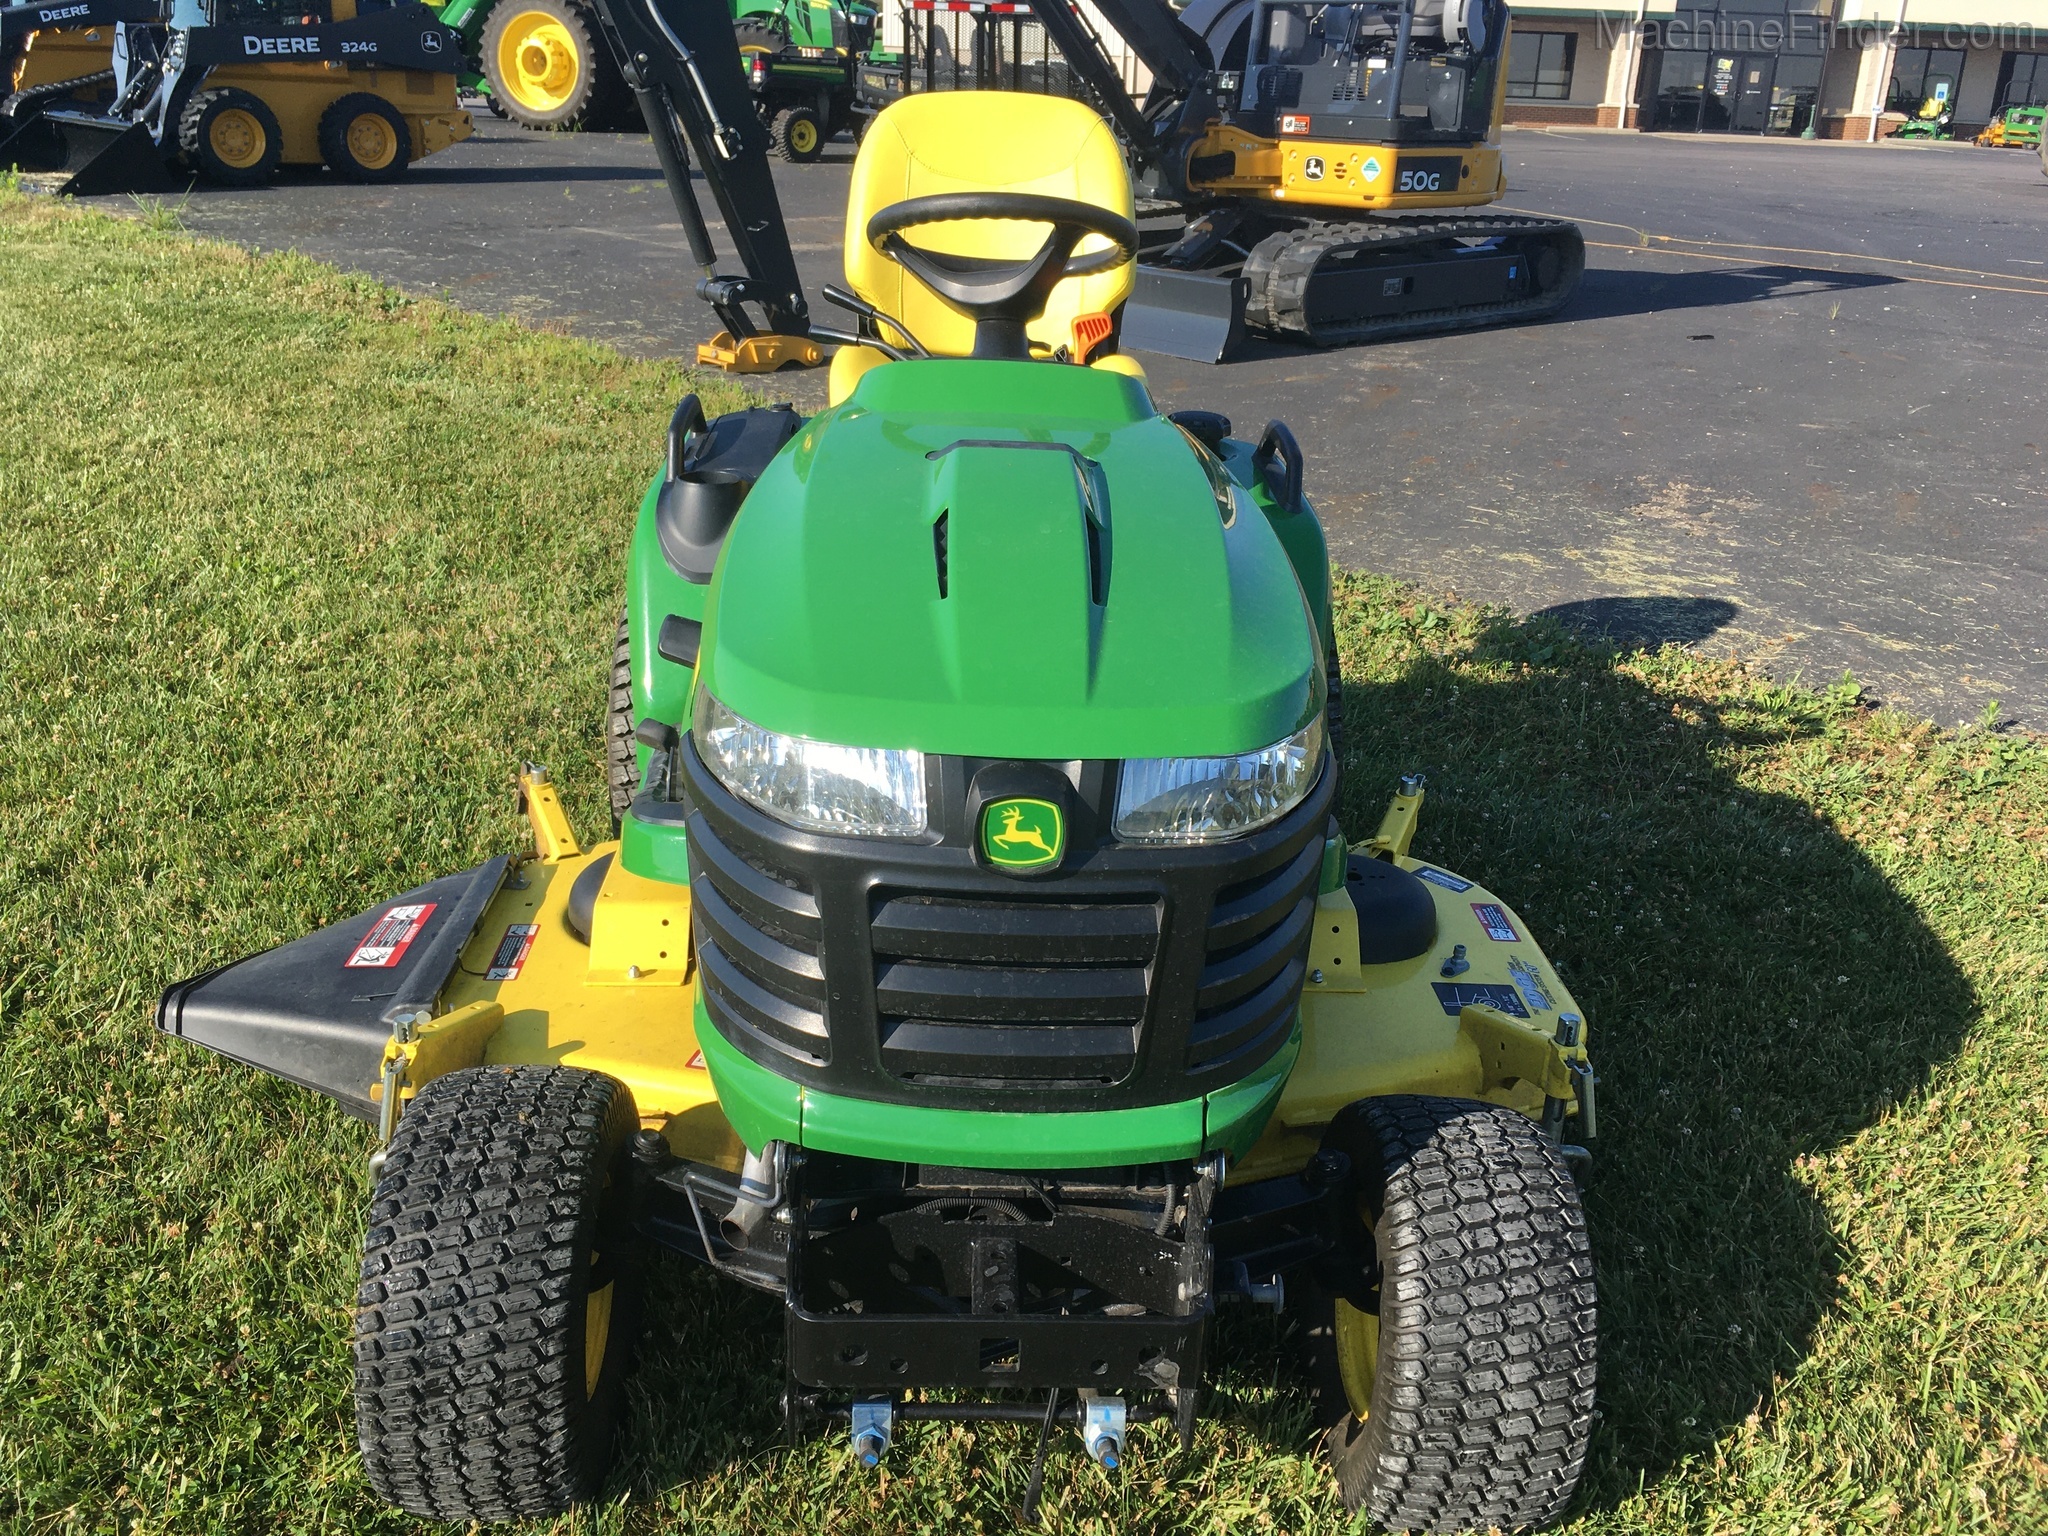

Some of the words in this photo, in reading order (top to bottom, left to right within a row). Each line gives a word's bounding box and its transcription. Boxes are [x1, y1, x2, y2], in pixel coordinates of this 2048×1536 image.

[39, 4, 90, 22] DEERE
[243, 36, 320, 54] DEERE
[341, 41, 377, 53] 324G
[1400, 171, 1440, 191] 50G
